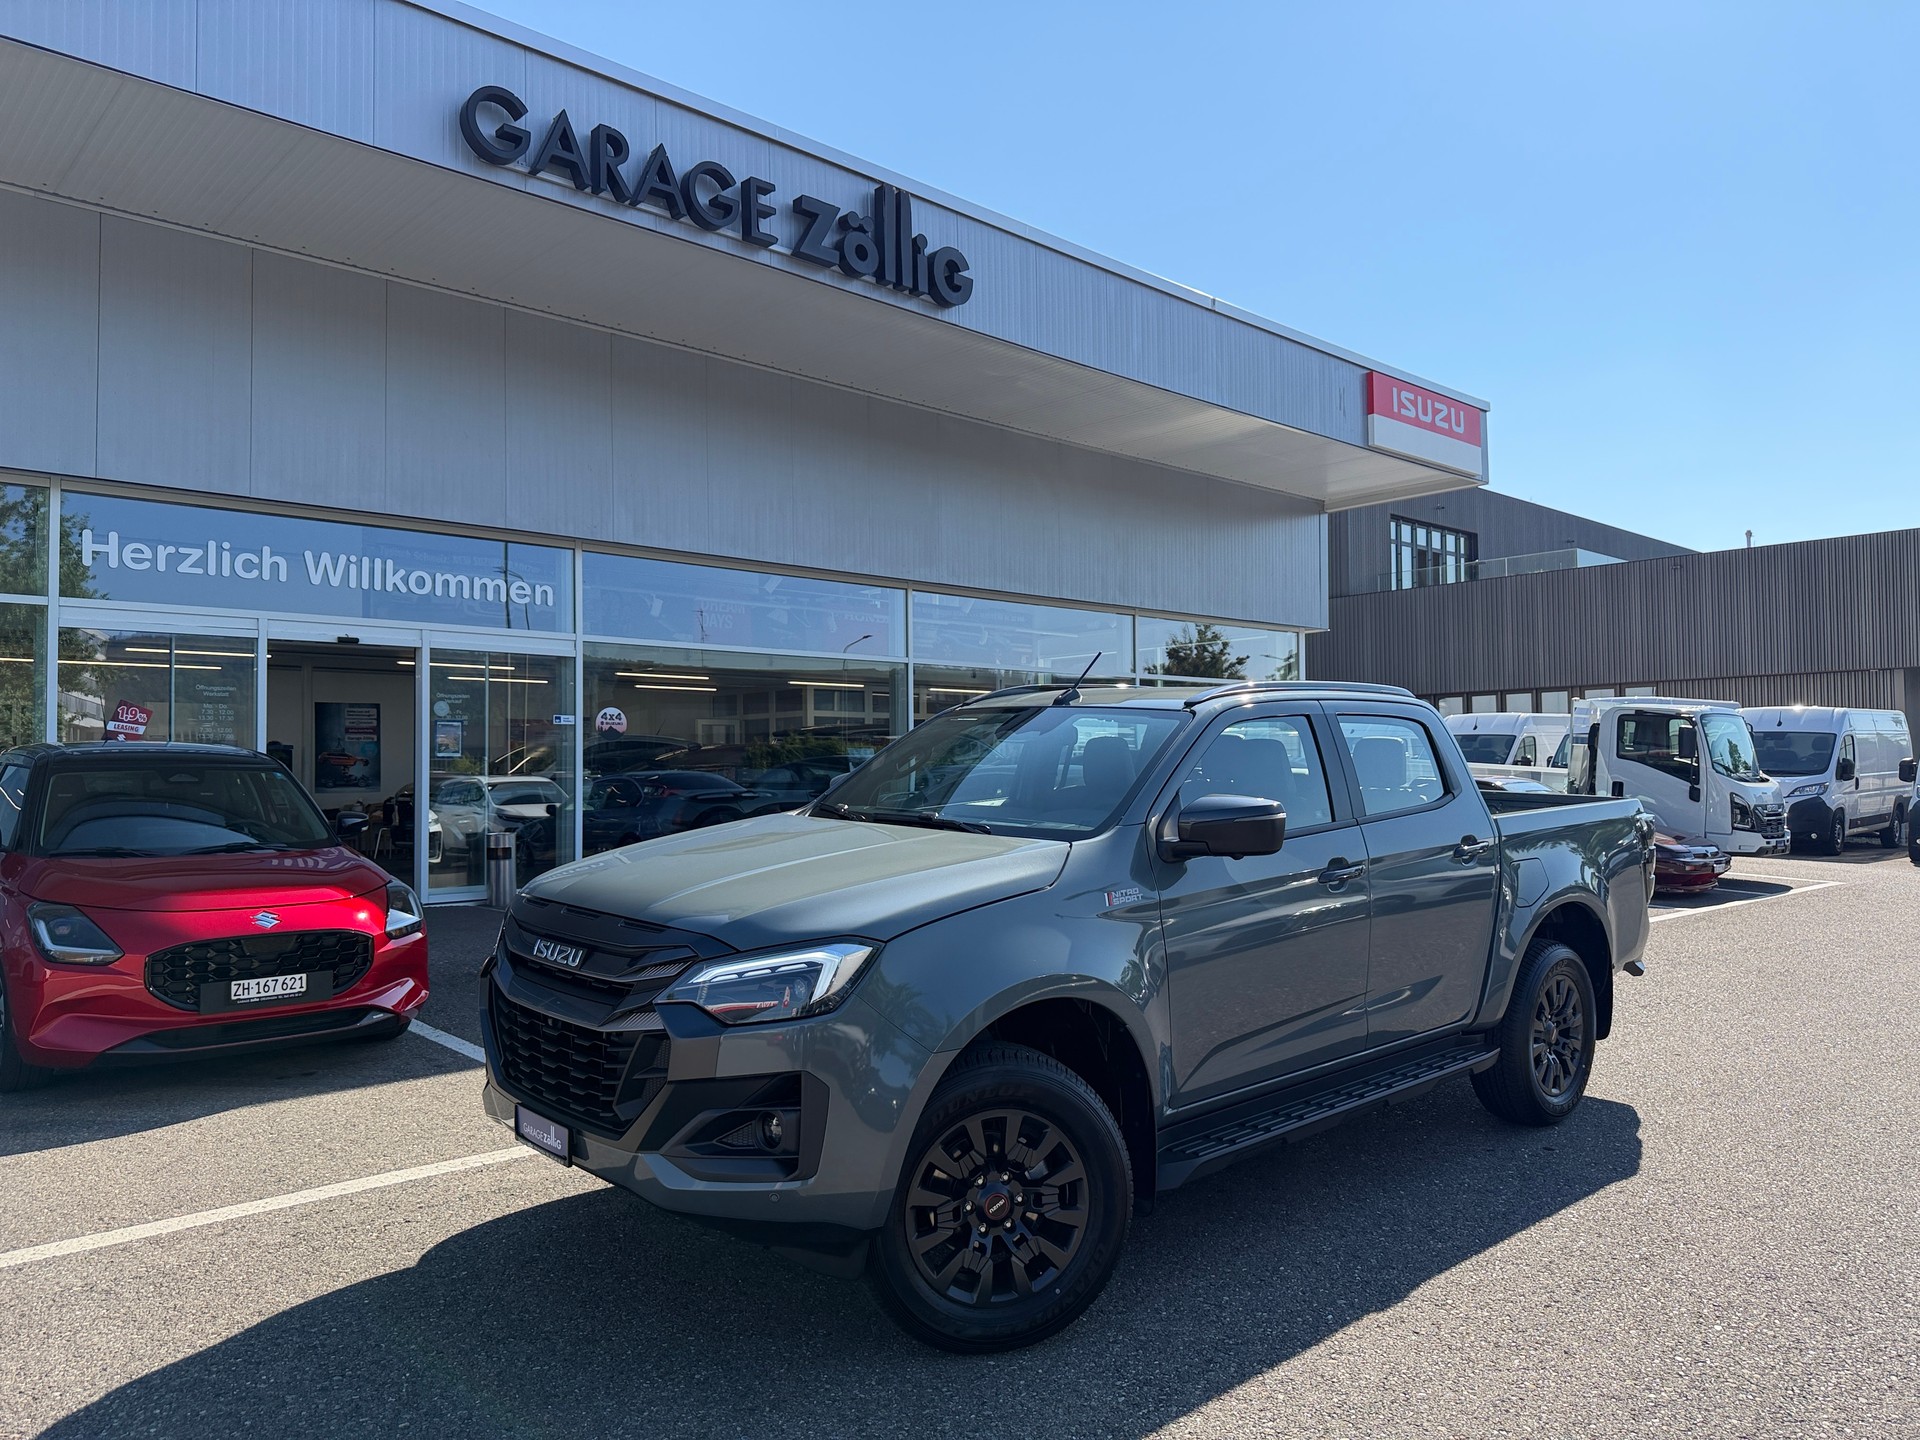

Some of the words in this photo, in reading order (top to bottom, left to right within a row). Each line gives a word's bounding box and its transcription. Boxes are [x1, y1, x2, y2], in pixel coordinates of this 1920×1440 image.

[459, 84, 779, 248] GARAGE
[1392, 387, 1465, 434] ISUZU
[81, 528, 288, 582] Herzlich
[303, 550, 554, 607] Willkommen
[601, 712, 622, 721] 4x4
[113, 723, 139, 732] LEASING
[1112, 887, 1139, 898] NITRO
[1112, 893, 1144, 905] SPORT
[533, 938, 583, 967] ISUZU
